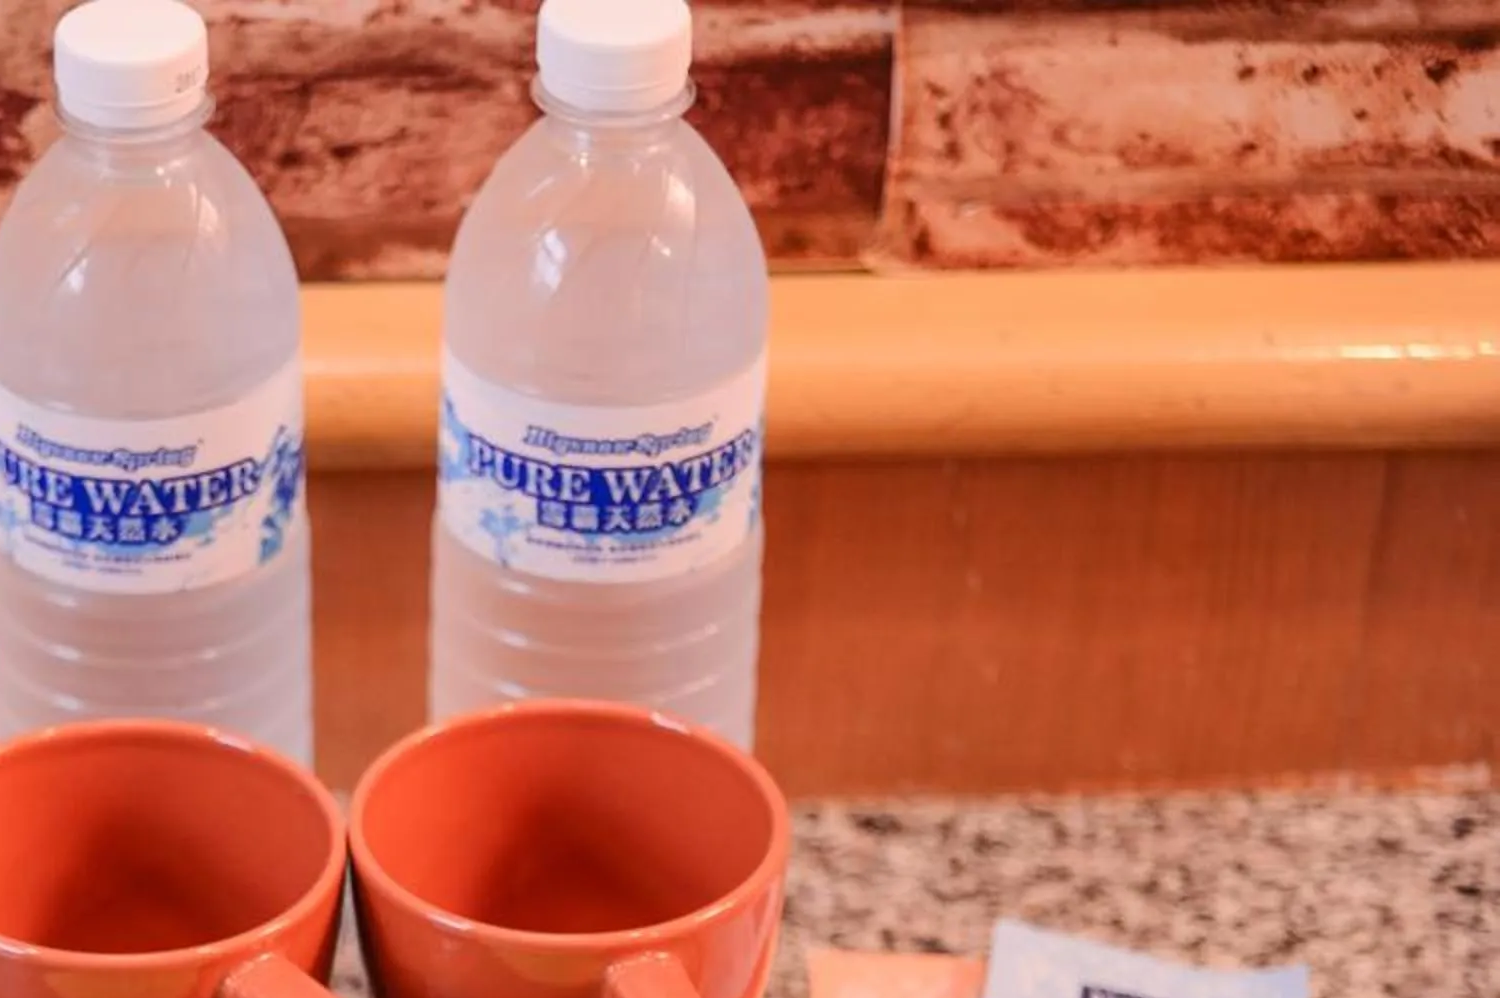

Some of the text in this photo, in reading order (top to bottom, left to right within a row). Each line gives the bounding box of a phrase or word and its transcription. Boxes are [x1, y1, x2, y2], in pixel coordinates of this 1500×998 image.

[82, 457, 261, 516] WATER
[468, 435, 592, 502] PURE
[602, 431, 754, 504] WATER
